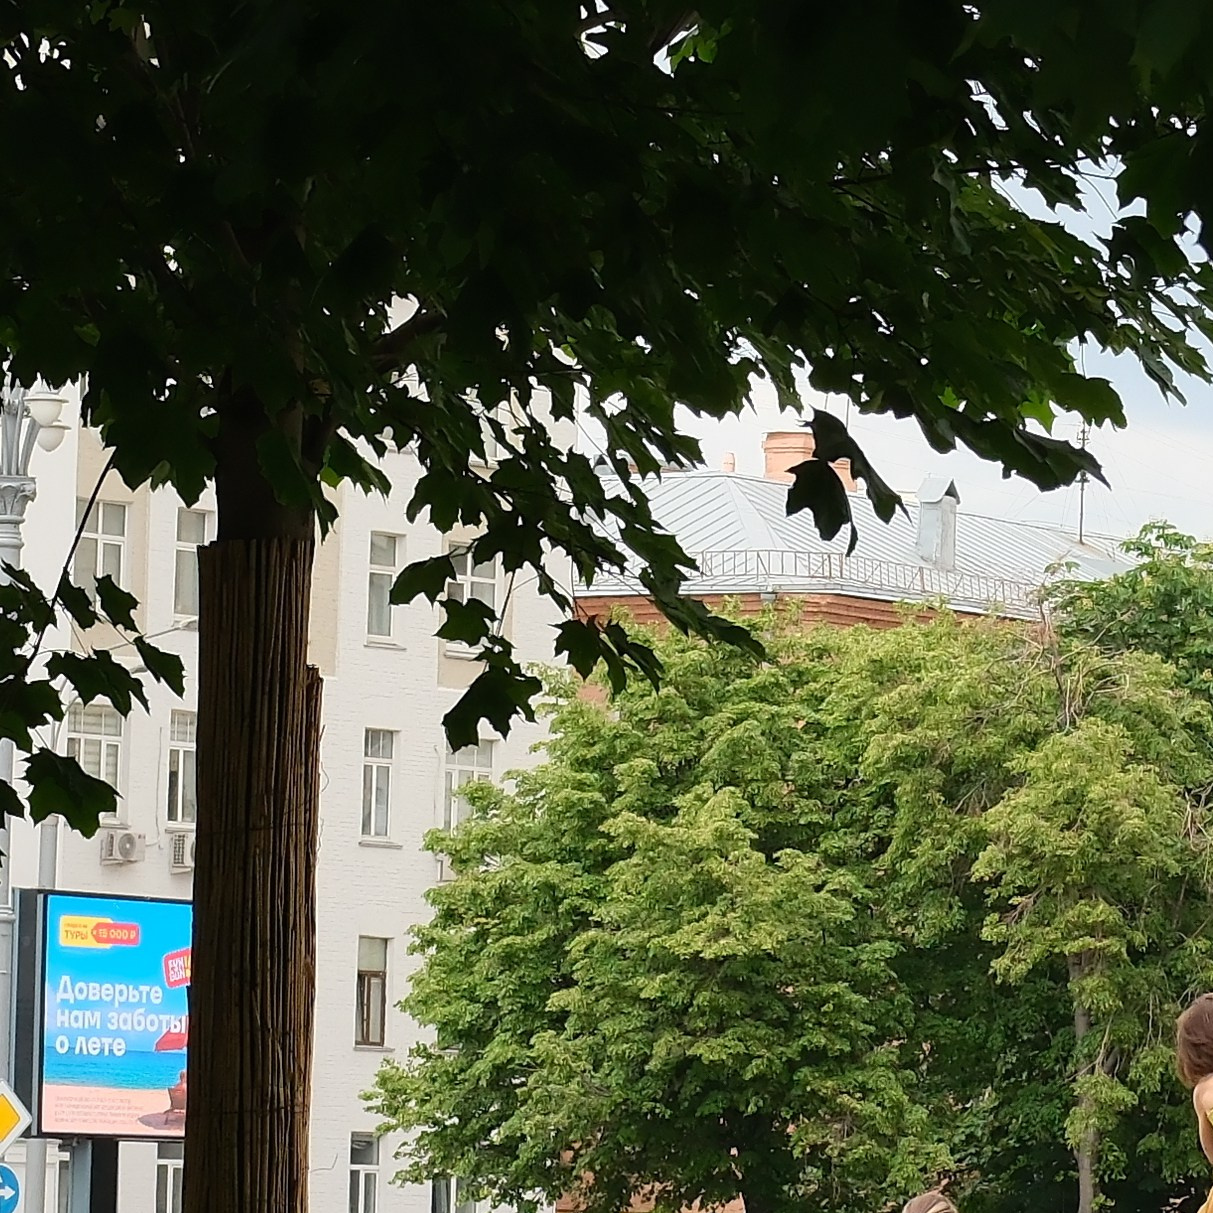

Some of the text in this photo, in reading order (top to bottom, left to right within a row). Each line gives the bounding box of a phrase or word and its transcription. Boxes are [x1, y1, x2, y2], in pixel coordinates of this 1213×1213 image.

[64, 929, 89, 940] ТУРЫ
[56, 975, 163, 1008] Доверьте
[56, 1007, 187, 1034] нам заботы
[55, 1036, 127, 1057] о лете
